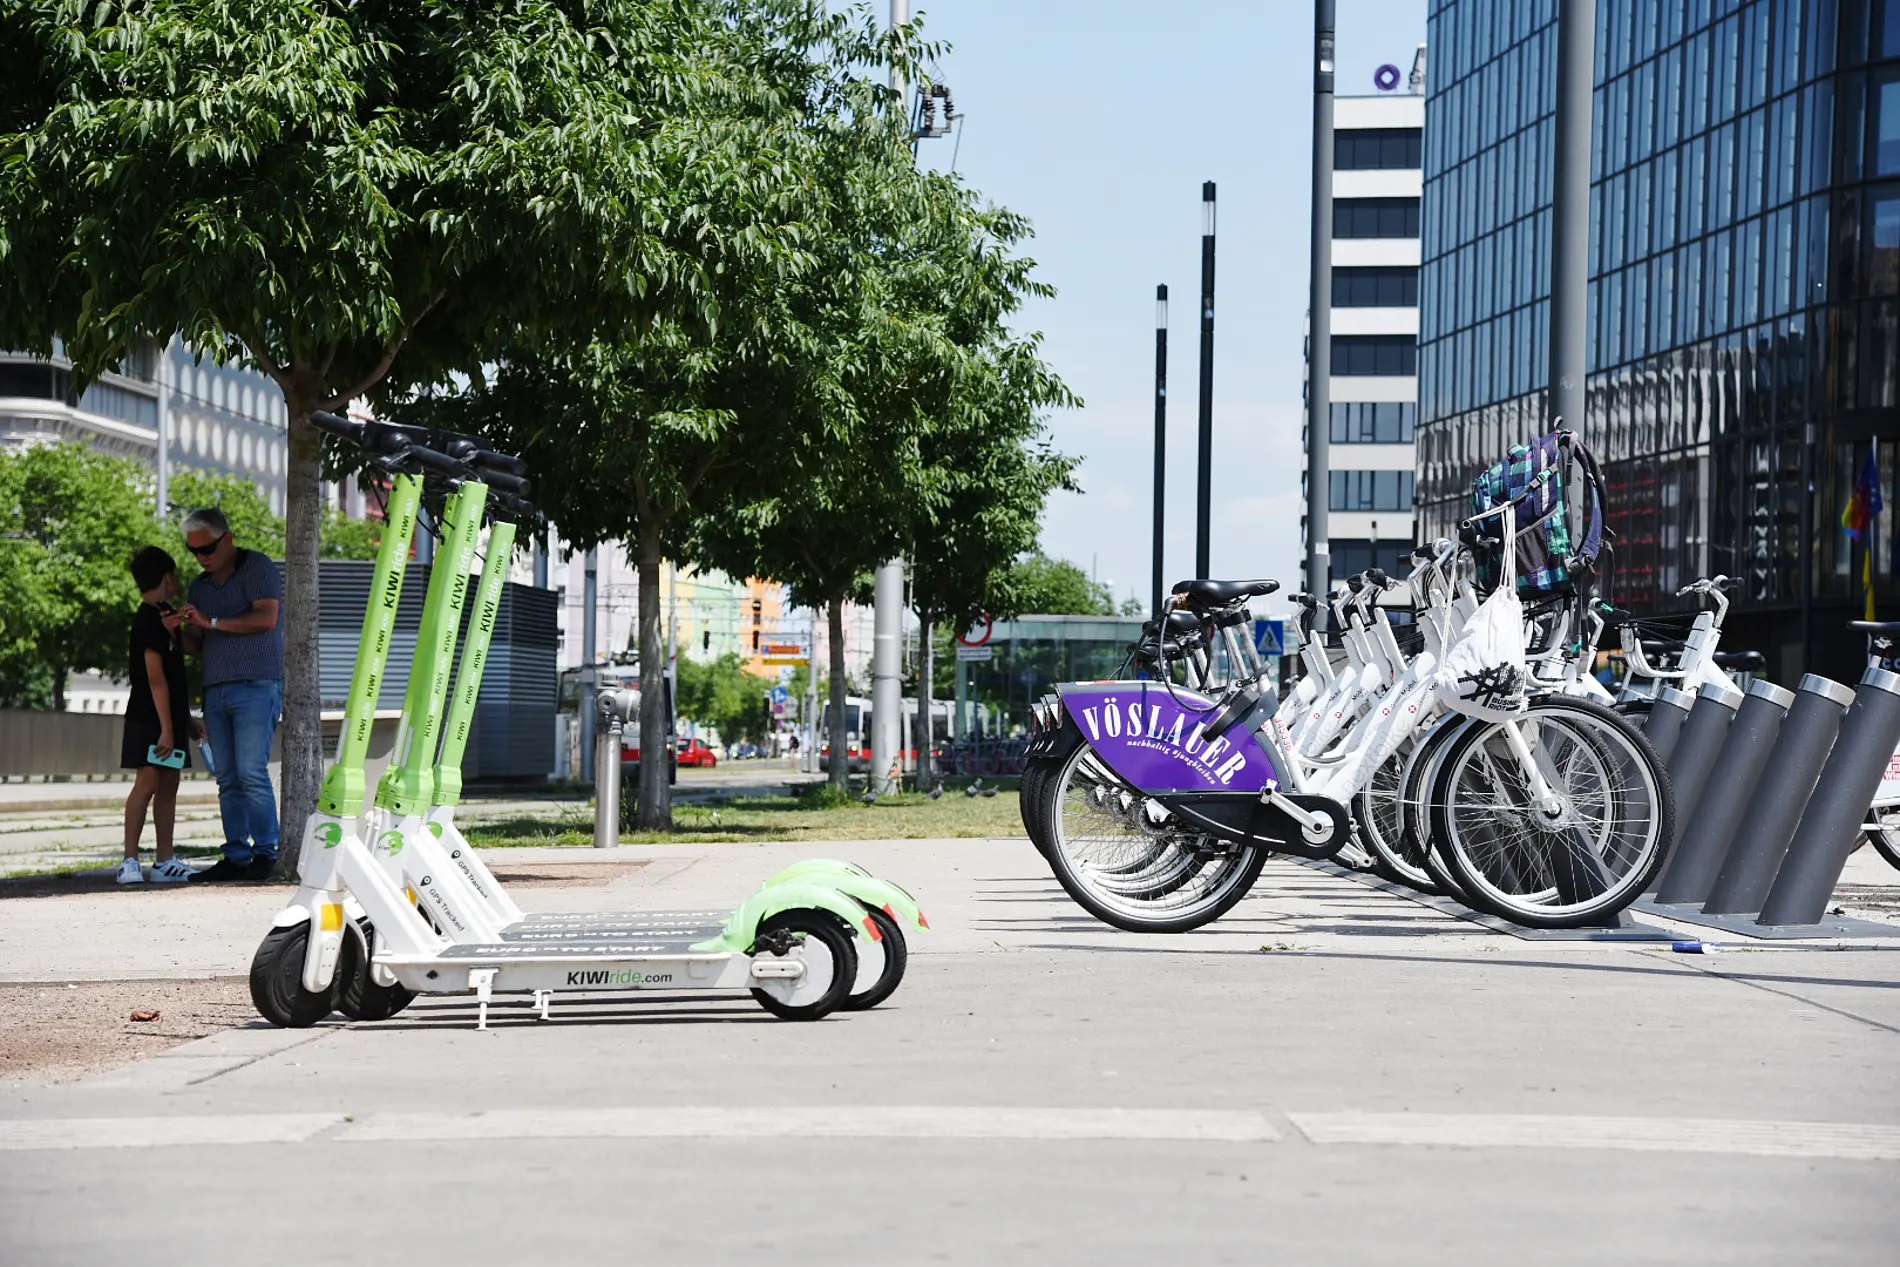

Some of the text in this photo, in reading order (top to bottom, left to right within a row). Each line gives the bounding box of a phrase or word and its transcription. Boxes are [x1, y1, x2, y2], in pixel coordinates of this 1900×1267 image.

[383, 541, 407, 609] KIWIride
[450, 546, 471, 610] KIWIride
[480, 577, 501, 633] KIWIride
[1488, 703, 1506, 711] RIOT
[1082, 697, 1247, 785] VÖSLAUER
[458, 860, 469, 875] GPS
[429, 888, 465, 932] GPS Tracked
[567, 968, 673, 986] KIWIride.com
